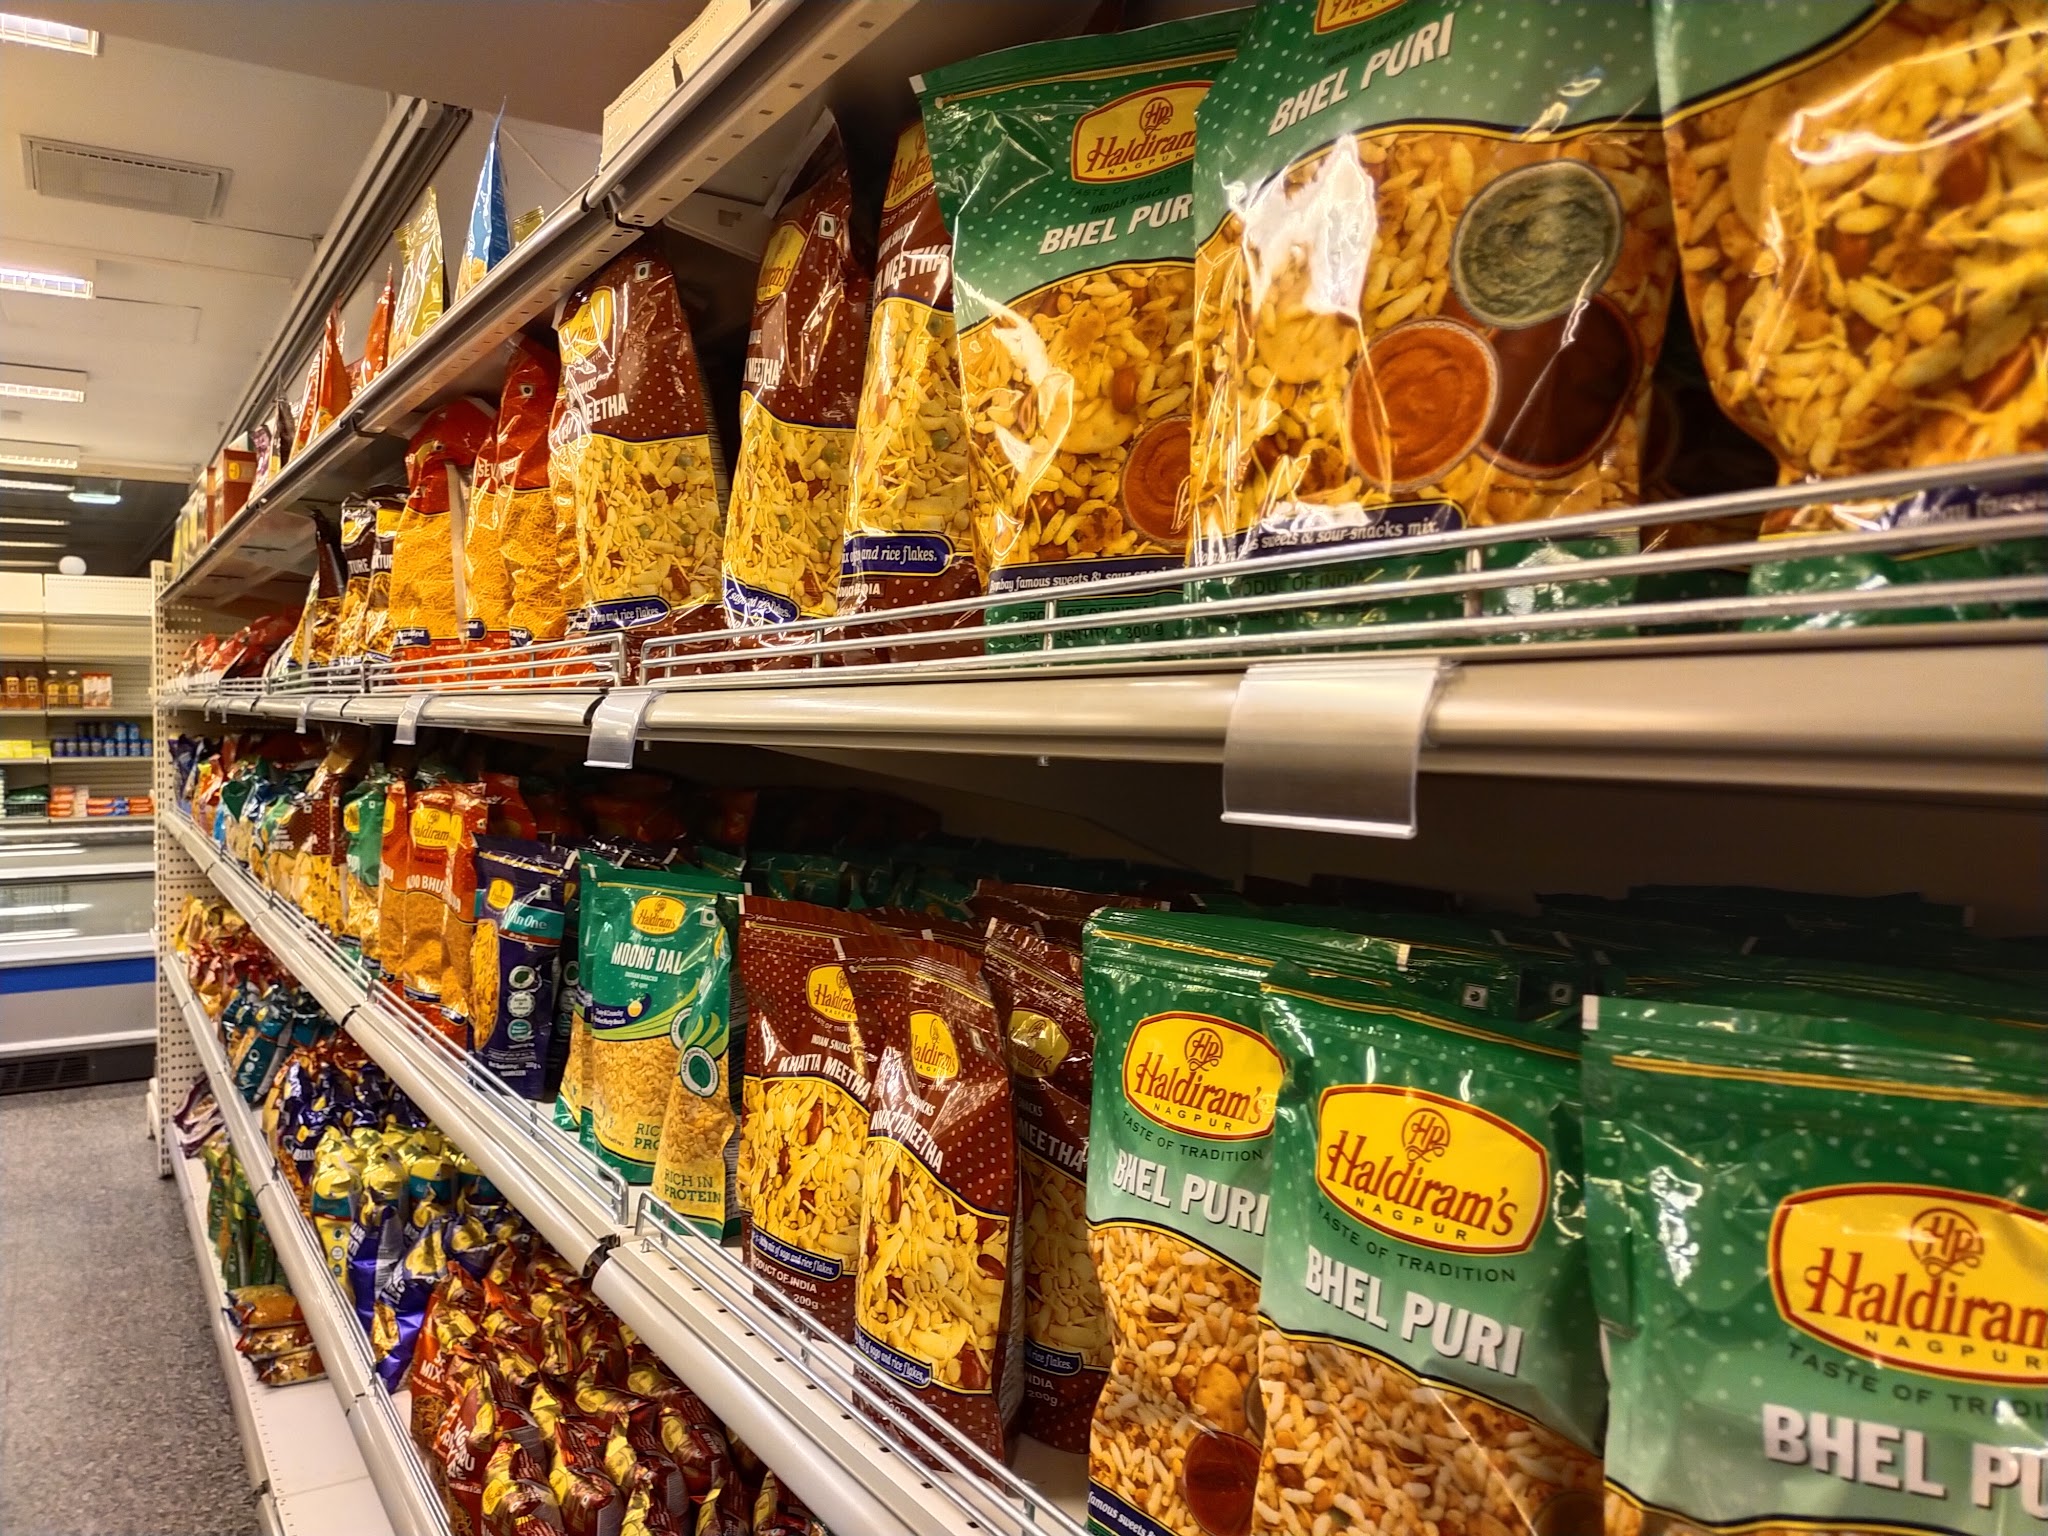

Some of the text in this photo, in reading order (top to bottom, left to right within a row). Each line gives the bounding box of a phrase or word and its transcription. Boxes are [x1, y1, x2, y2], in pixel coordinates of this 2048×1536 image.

[1267, 67, 1349, 137] BHEL
[1360, 12, 1454, 90] PURI
[1107, 151, 1184, 176] NAGPUR
[1038, 193, 1194, 255] BHEL PUR
[586, 392, 629, 425] EETHA
[1315, 527, 1350, 544] sour
[1350, 520, 1404, 541] snacks
[881, 545, 900, 561] rice
[900, 545, 938, 566] flakes.
[1015, 574, 1051, 592] famous
[1052, 571, 1089, 587] sweets
[1091, 571, 1102, 583] &
[1125, 623, 1150, 640] 300
[524, 915, 547, 930] One
[610, 941, 684, 976] MOONG DAL
[829, 1039, 852, 1054] SNACKS
[777, 1053, 873, 1102] KHATTA MEETHA
[1134, 1052, 1263, 1125] Haldiram's
[1153, 1103, 1233, 1132] NAGPUR
[1018, 1116, 1084, 1174] MEETHA
[1121, 1110, 1264, 1162] TASTE OF TRADITION
[663, 1185, 721, 1205] PROTEIN
[664, 1168, 714, 1189] RICH IN
[1112, 1148, 1271, 1237] BHEL PURI
[1326, 1130, 1519, 1237] Haldiram's
[1355, 1197, 1468, 1242] NAGPUR
[1316, 1200, 1517, 1283] TASTE OF TRADITION
[776, 1271, 789, 1284] OF
[789, 1276, 818, 1293] INDIA
[793, 1293, 819, 1310] 200g
[1305, 1244, 1525, 1377] BHEL PURI
[891, 1357, 903, 1372] rice
[1864, 1329, 2043, 1370] NAGPUR
[1786, 1341, 1879, 1393] TASTE
[1892, 1383, 1933, 1403] OF
[1026, 1390, 1058, 1407] 200g
[1762, 1403, 1948, 1500] BHEL
